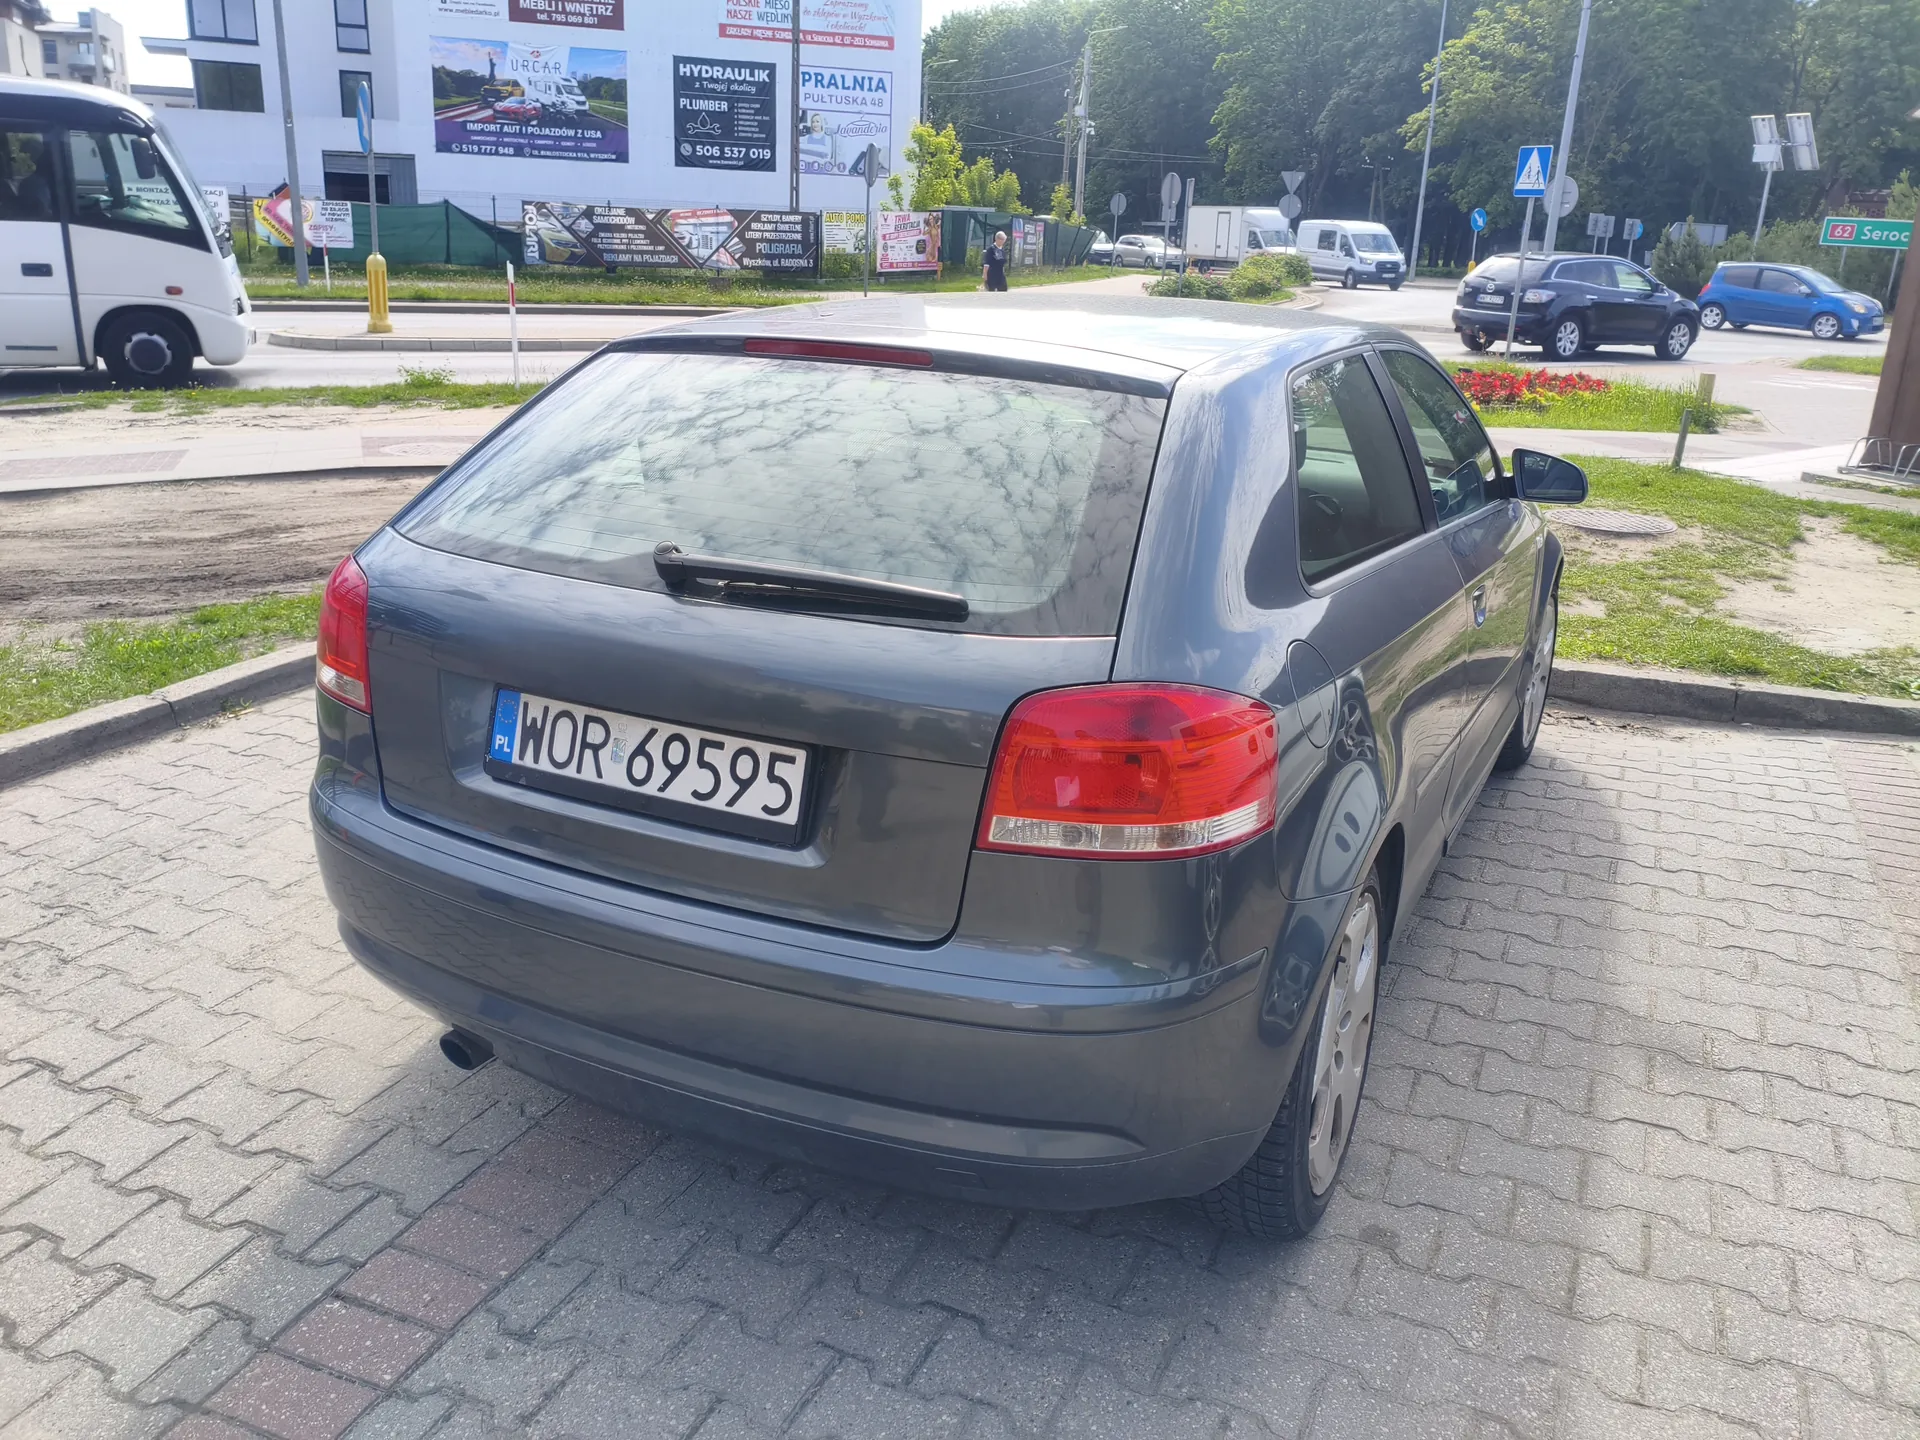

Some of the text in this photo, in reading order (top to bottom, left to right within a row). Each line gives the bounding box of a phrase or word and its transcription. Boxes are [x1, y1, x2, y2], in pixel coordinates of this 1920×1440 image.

[519, 0, 613, 16] MEBLI I WNĘTRZ
[727, 9, 752, 20] NASZE
[567, 15, 582, 23] 069
[511, 59, 562, 75] URCAR
[679, 63, 770, 82] HYDRAULIK
[702, 81, 728, 92] Twojej
[730, 83, 756, 94] okolicy
[801, 71, 888, 93] PRALNIA
[680, 98, 728, 112] PLUMBER
[804, 92, 884, 108] PUŁTUSKA 48
[466, 122, 602, 139] IMPORT AUT I POJAZDÓW Z USA
[462, 144, 514, 155] 519 777 948
[696, 145, 771, 159] 506 537 019
[592, 215, 635, 224] SAMOCHODÓW
[782, 214, 802, 222] BANERY
[825, 211, 866, 224] AUTO POMO
[751, 222, 802, 231] REKLAMY ŚWIETLNE
[745, 231, 762, 239] LITERY
[1834, 225, 1910, 242] 62 Seroc
[756, 242, 803, 255] POLIGRAFIA
[603, 252, 679, 264] REKLAMY NA POJAZDACH
[743, 257, 772, 268] Wyszków,
[781, 259, 808, 268] RADOSNA
[809, 259, 814, 267] 3
[495, 734, 511, 753] PL
[518, 701, 798, 817] WOR 69595
